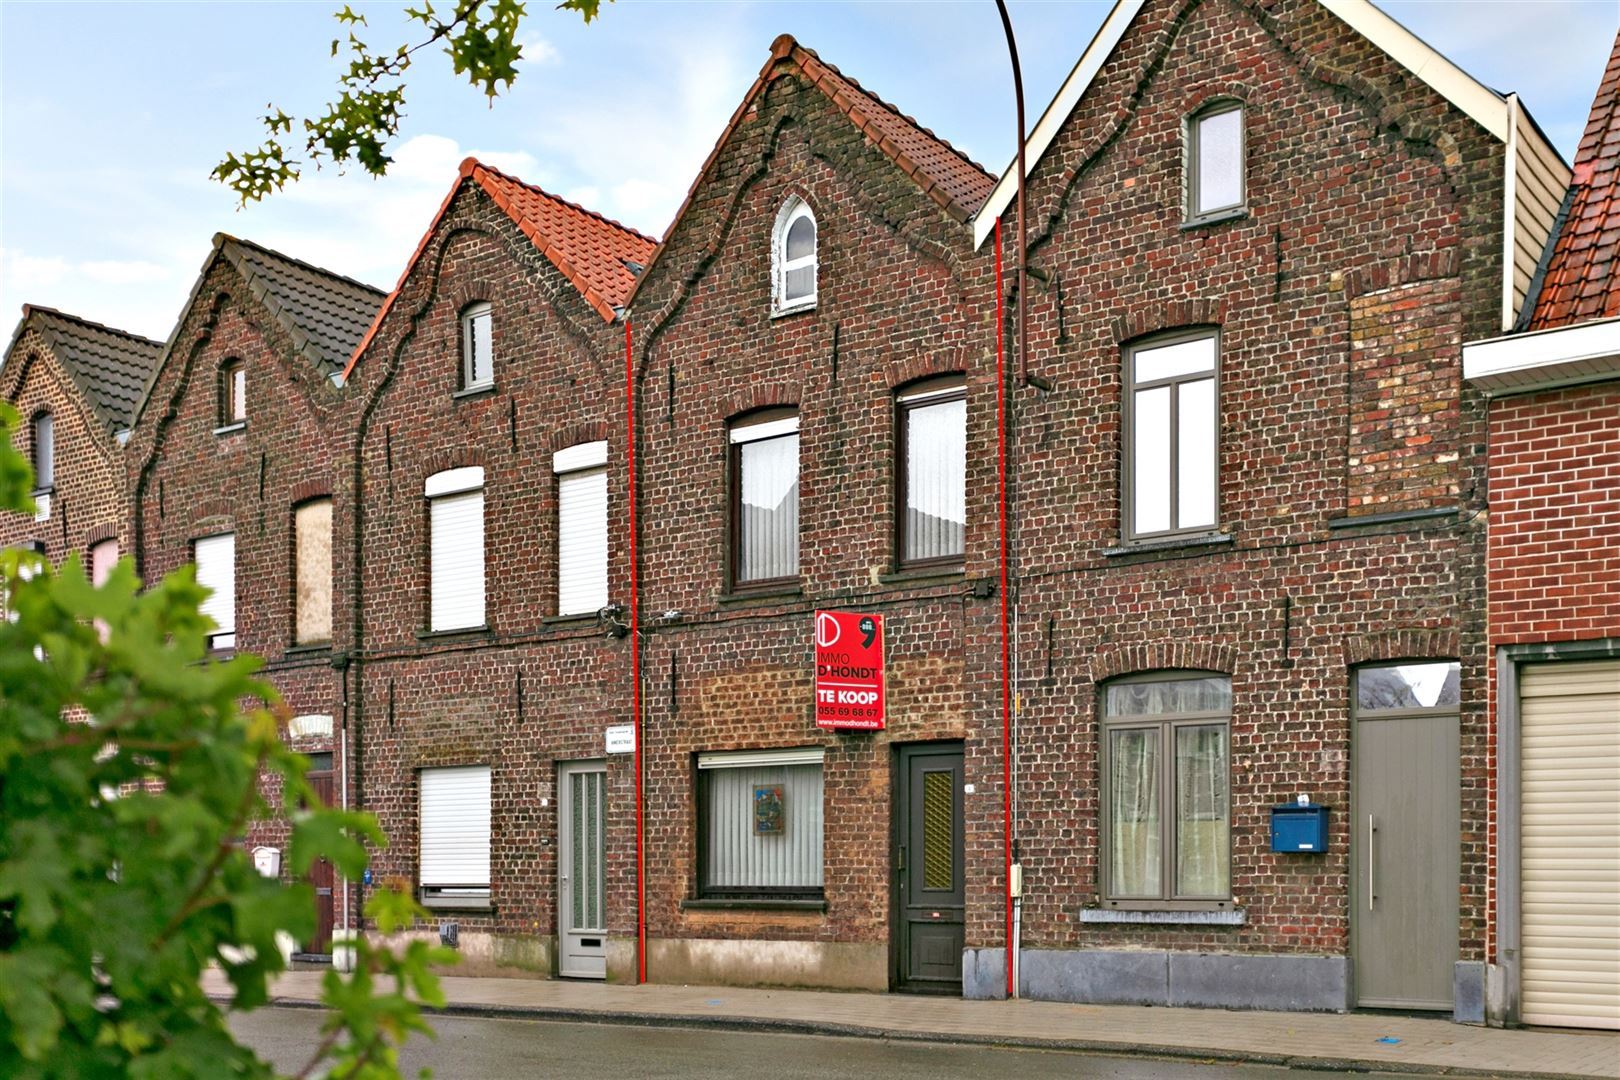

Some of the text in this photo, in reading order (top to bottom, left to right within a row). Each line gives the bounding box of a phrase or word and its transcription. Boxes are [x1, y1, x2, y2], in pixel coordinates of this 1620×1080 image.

[817, 652, 850, 665] IMMO
[818, 665, 877, 679] D'HONDT
[818, 690, 878, 705] TE KOOP
[818, 706, 878, 718] 055 69 68 67
[818, 719, 878, 728] www.immodhondt.be
